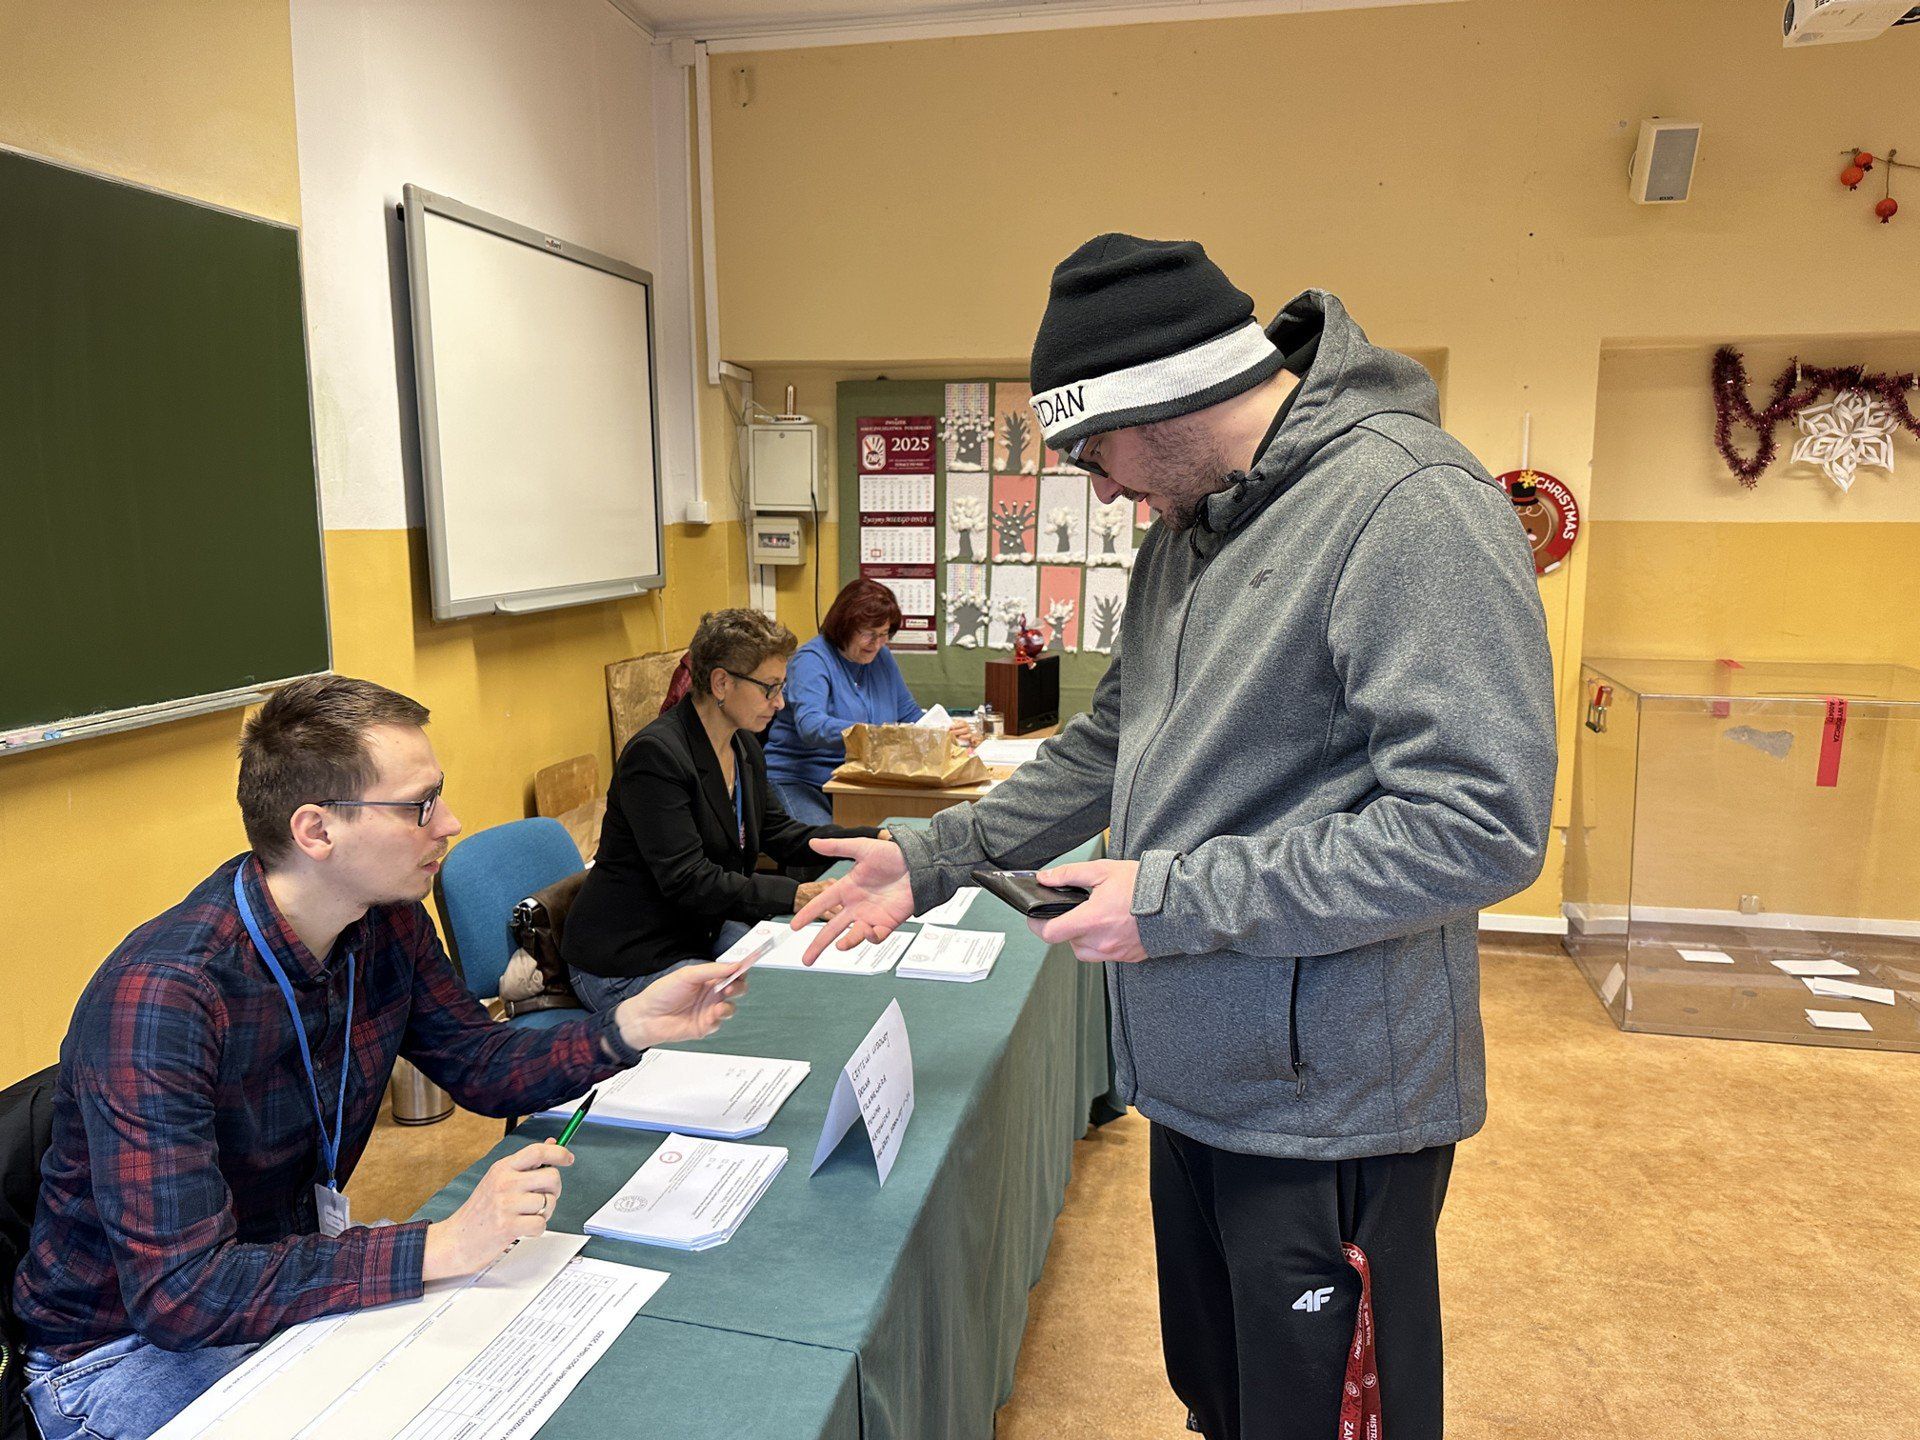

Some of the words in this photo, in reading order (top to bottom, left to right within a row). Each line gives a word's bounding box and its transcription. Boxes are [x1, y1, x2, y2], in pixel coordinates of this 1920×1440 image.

[891, 437, 930, 452] 2025
[1535, 476, 1578, 540] CHRISTMAS
[1833, 706, 1843, 742] WYBORCZA
[1291, 1286, 1335, 1313] 4F
